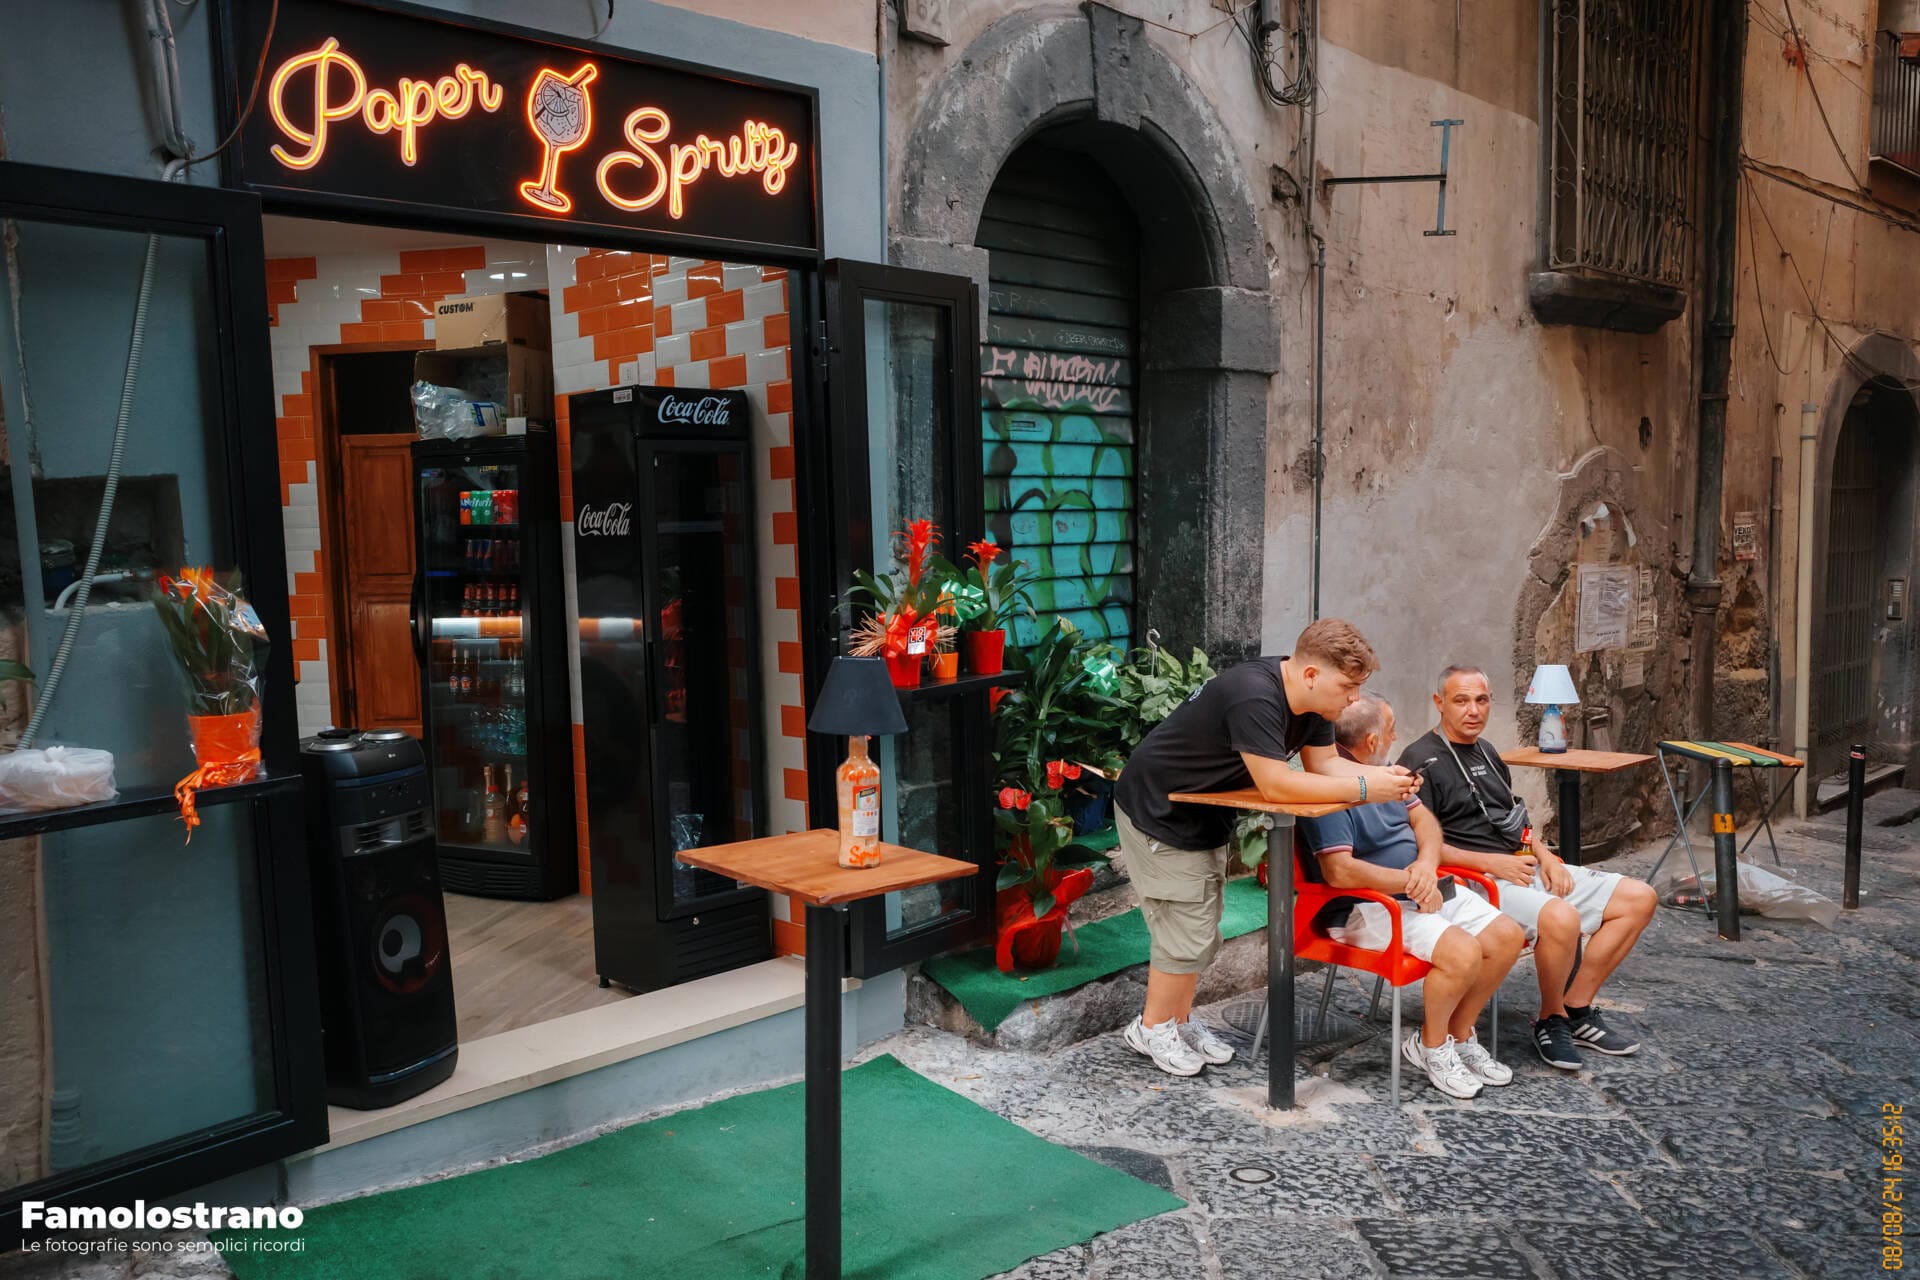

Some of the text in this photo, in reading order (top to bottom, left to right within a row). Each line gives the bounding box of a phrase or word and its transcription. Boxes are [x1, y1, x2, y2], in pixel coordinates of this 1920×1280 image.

[269, 37, 798, 220] Paper Spritz
[438, 302, 474, 315] CUSTOM
[657, 394, 732, 425] Coca-Cola
[578, 502, 632, 537] Coca-Cola
